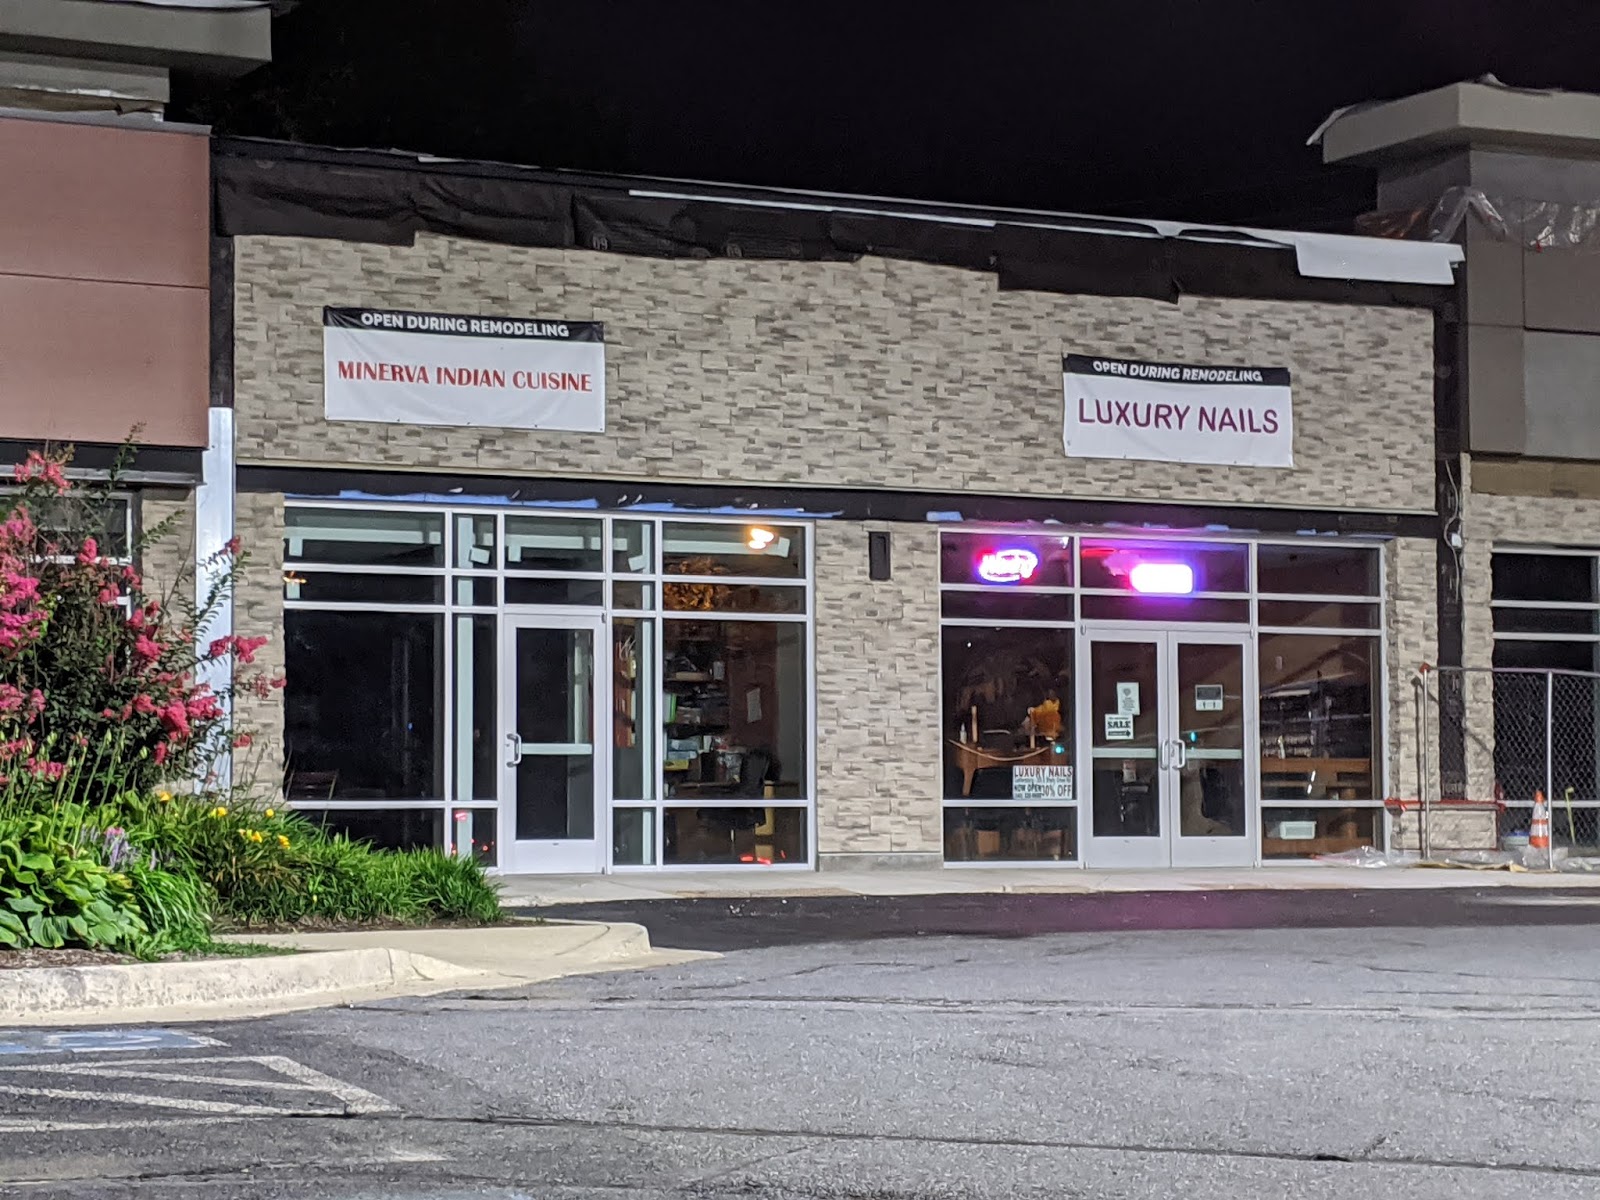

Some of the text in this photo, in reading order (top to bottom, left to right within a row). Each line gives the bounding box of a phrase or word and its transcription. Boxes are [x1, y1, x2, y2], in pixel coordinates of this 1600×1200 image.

[361, 313, 569, 337] OPEN DURING REMODELING
[338, 361, 593, 392] MINERVA INDIAN CUISINE
[1092, 361, 1263, 382] OPEN DURING REMODELING
[1078, 398, 1279, 434] LUXURY NAILS
[1107, 721, 1130, 729] SALE
[1015, 767, 1072, 778] LUXURY NAILS
[1027, 783, 1041, 792] OPEN
[1057, 784, 1072, 797] OFF
